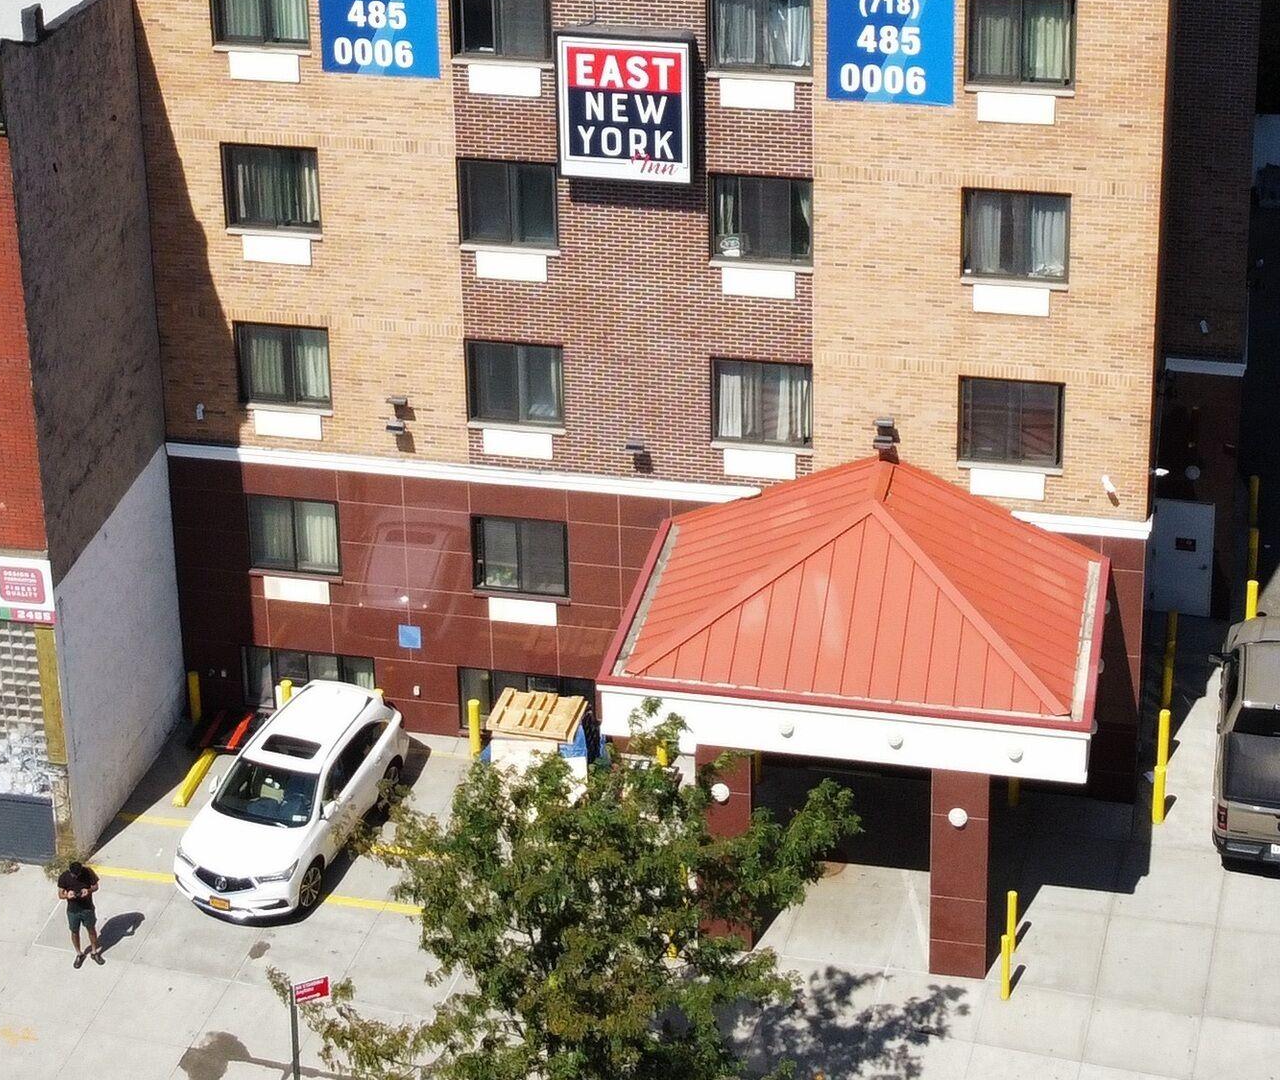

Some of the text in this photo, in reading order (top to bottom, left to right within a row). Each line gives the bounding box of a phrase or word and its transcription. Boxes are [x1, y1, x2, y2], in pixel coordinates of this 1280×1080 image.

[347, 0, 407, 30] 485
[333, 36, 414, 68] 0006
[856, 25, 921, 55] 485
[575, 53, 675, 91] EAST
[840, 63, 926, 95] 0006
[585, 91, 668, 125] NEW
[577, 125, 674, 160] YORK
